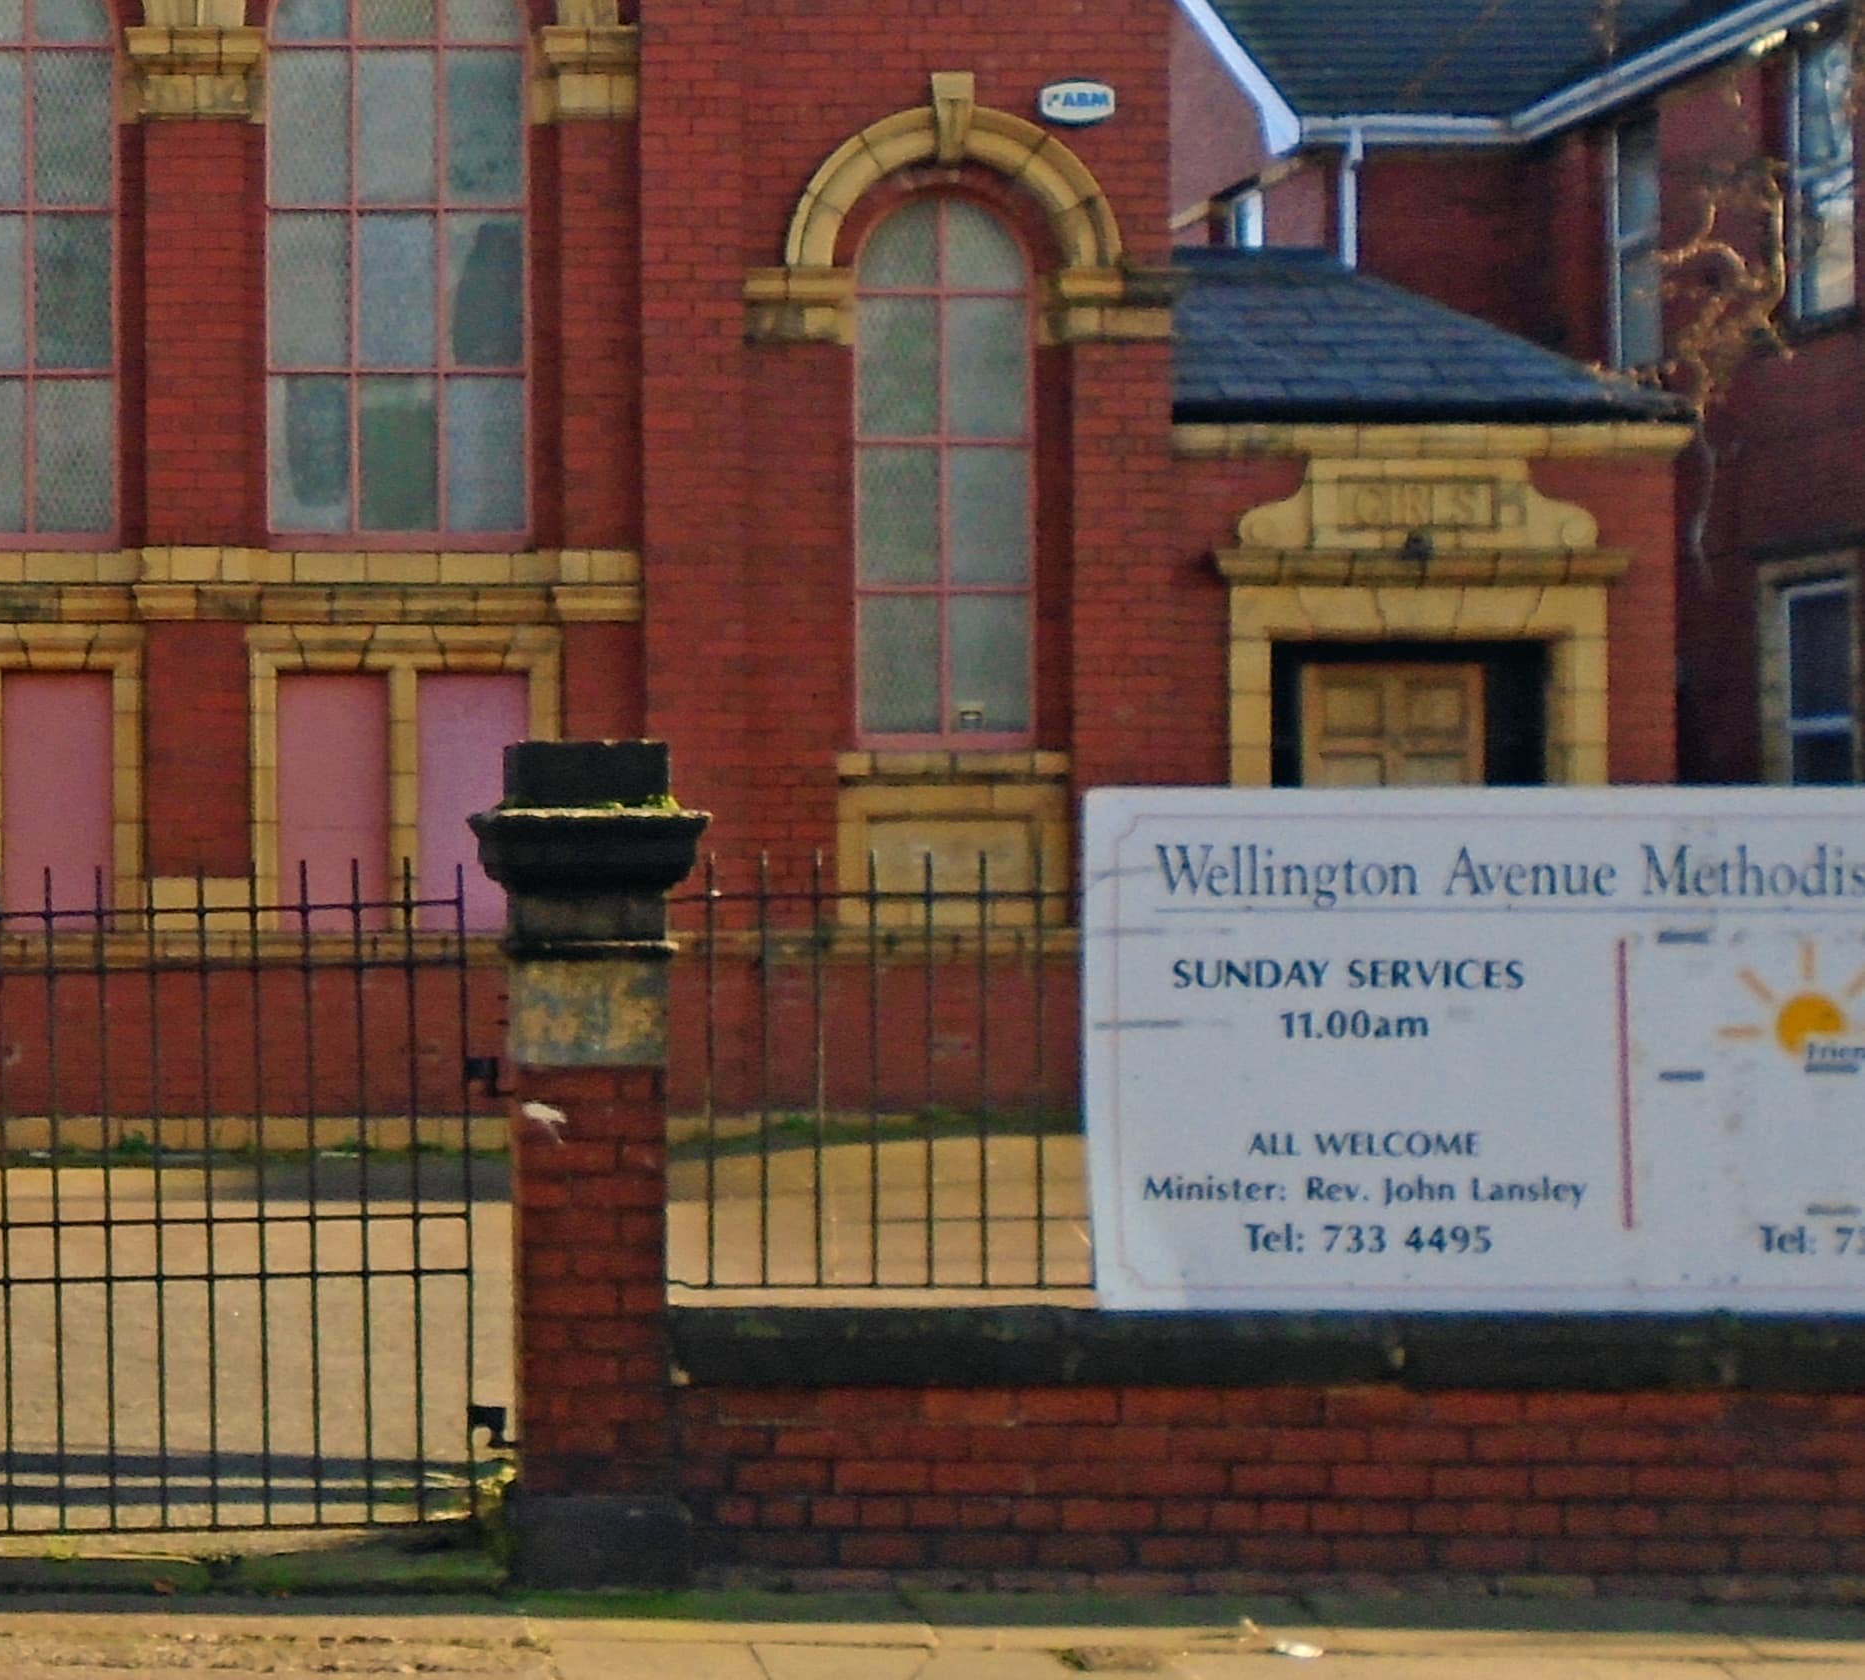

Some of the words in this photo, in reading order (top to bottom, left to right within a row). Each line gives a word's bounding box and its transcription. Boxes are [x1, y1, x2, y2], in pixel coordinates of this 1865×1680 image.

[1353, 483, 1478, 526] GIRLS
[1154, 843, 1421, 908] Wellington
[1445, 843, 1618, 896] Avenue
[1172, 959, 1330, 990] SUNDAY
[1347, 959, 1526, 990] SERVICES
[1279, 1009, 1430, 1039] 11.00am
[1247, 1131, 1301, 1158] ALL
[1314, 1131, 1480, 1158] WELCOME
[1142, 1175, 1287, 1202] Minister:
[1305, 1175, 1369, 1202] Rev.
[1384, 1175, 1457, 1207] John
[1471, 1175, 1589, 1208] Lansley
[1245, 1223, 1305, 1254] Tel:
[1322, 1224, 1386, 1254] 733
[1404, 1224, 1494, 1254] 4495
[1758, 1224, 1817, 1255] Tel:
